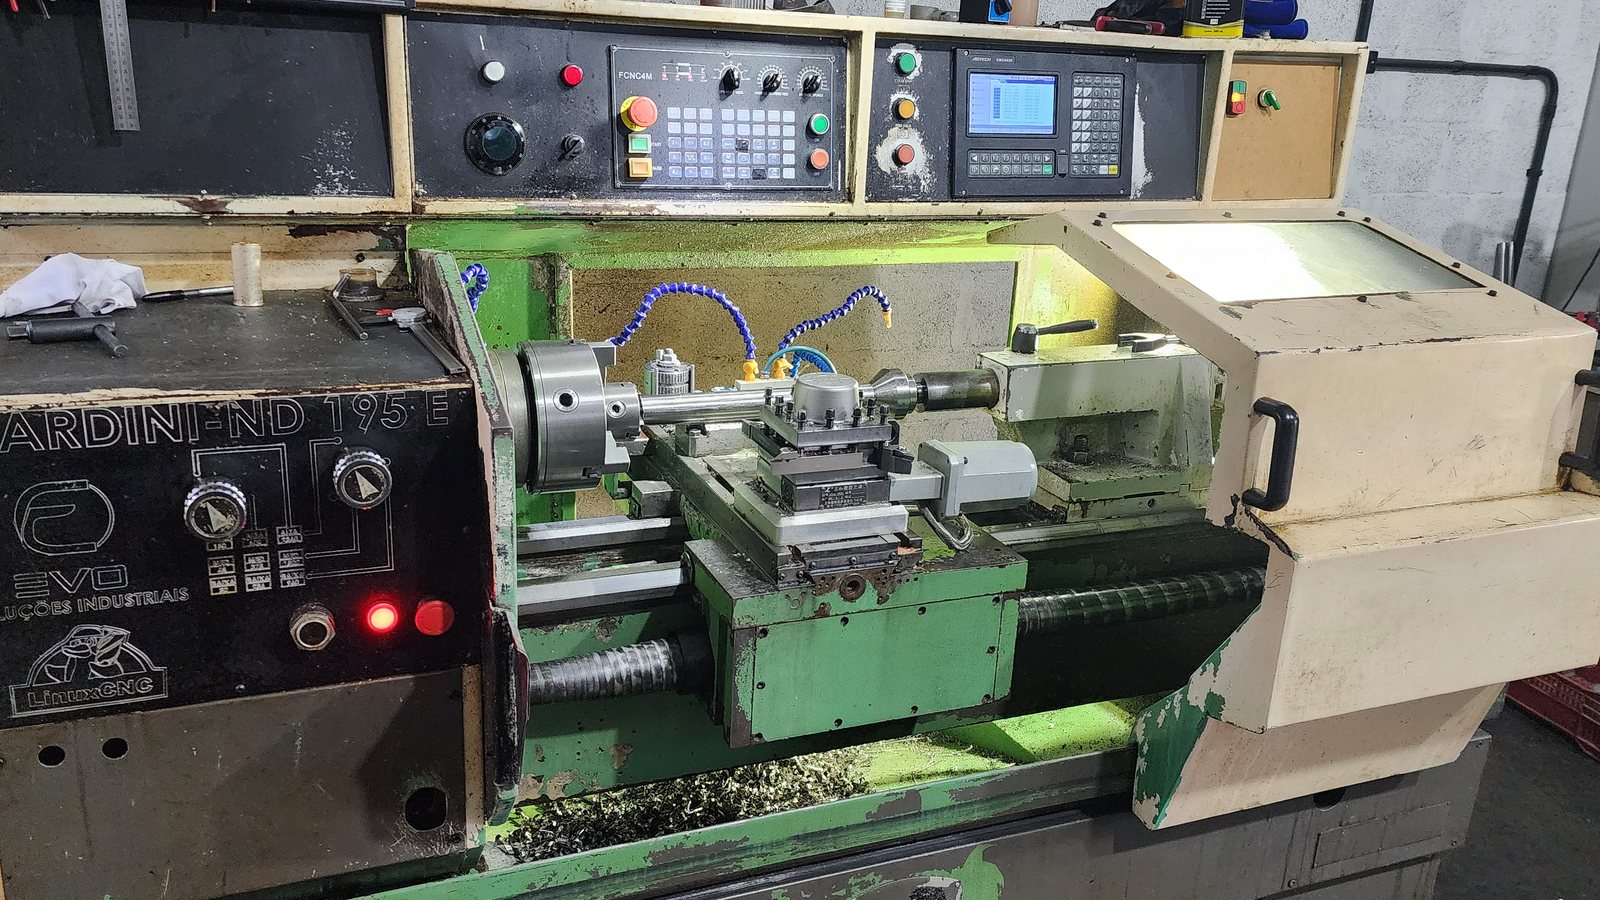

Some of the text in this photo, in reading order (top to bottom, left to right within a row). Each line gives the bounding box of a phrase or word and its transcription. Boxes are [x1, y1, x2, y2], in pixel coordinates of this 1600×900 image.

[618, 71, 653, 80] FCNC4M
[324, 392, 408, 434] 195
[426, 390, 449, 426] E
[13, 564, 129, 599] EVO
[77, 587, 190, 612] INDUSTRIAIS
[27, 677, 154, 708] LinuxCNC
